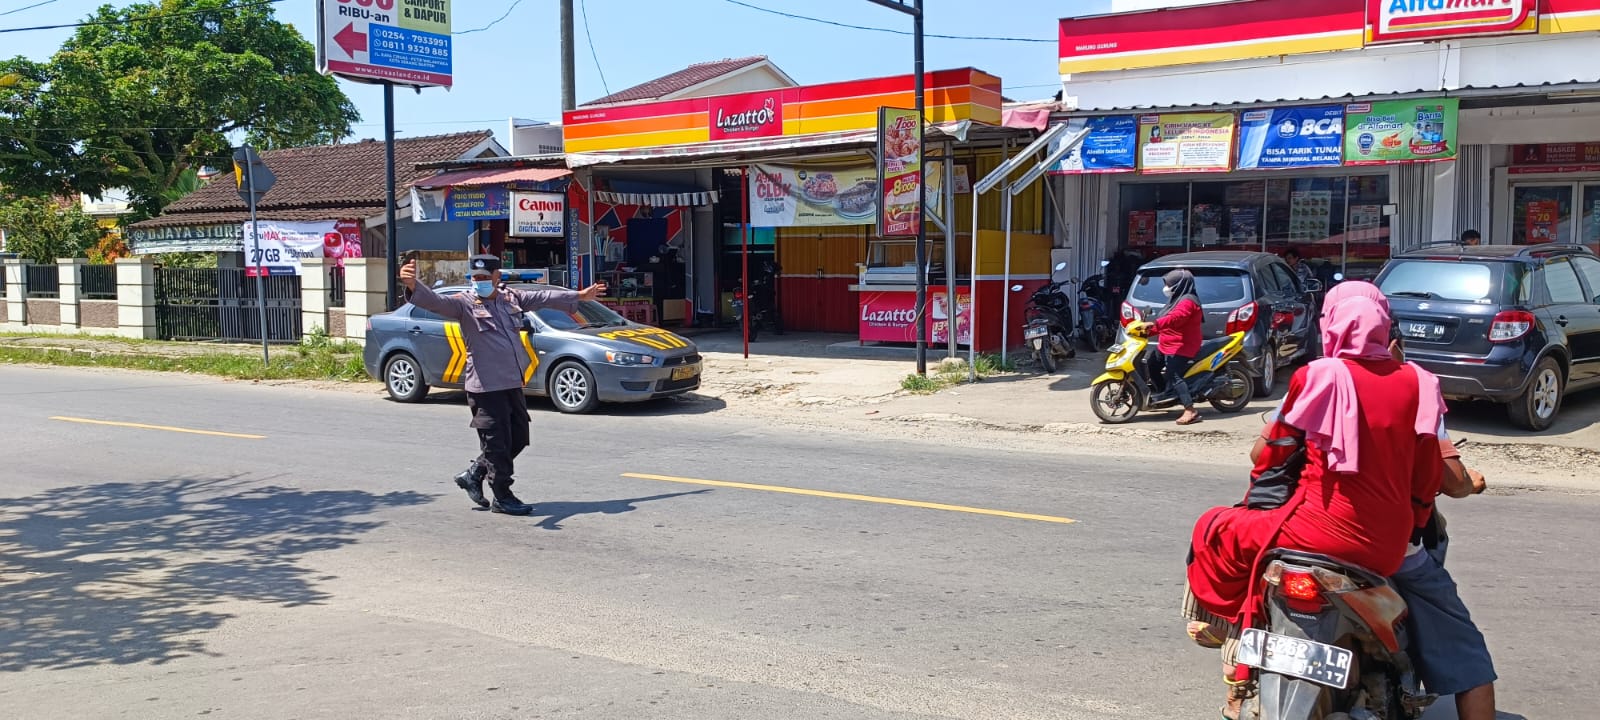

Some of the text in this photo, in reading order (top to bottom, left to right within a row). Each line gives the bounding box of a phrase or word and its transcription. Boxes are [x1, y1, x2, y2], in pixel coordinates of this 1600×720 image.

[339, 6, 390, 23] RIBU-an
[404, 7, 447, 24] & DAPUR
[382, 31, 405, 41] 0254
[412, 35, 448, 48] 7933991
[382, 41, 449, 57] 0811 9329 885
[717, 108, 768, 127] Lazatto
[1299, 118, 1342, 136] BCA
[519, 199, 562, 211] Canon
[196, 223, 242, 238] STORE
[249, 230, 280, 241] SruMAX
[862, 304, 917, 322] Lazatto
[1410, 323, 1426, 333] 1432
[1290, 612, 1317, 620] HONDA
[1325, 647, 1349, 669] LR
